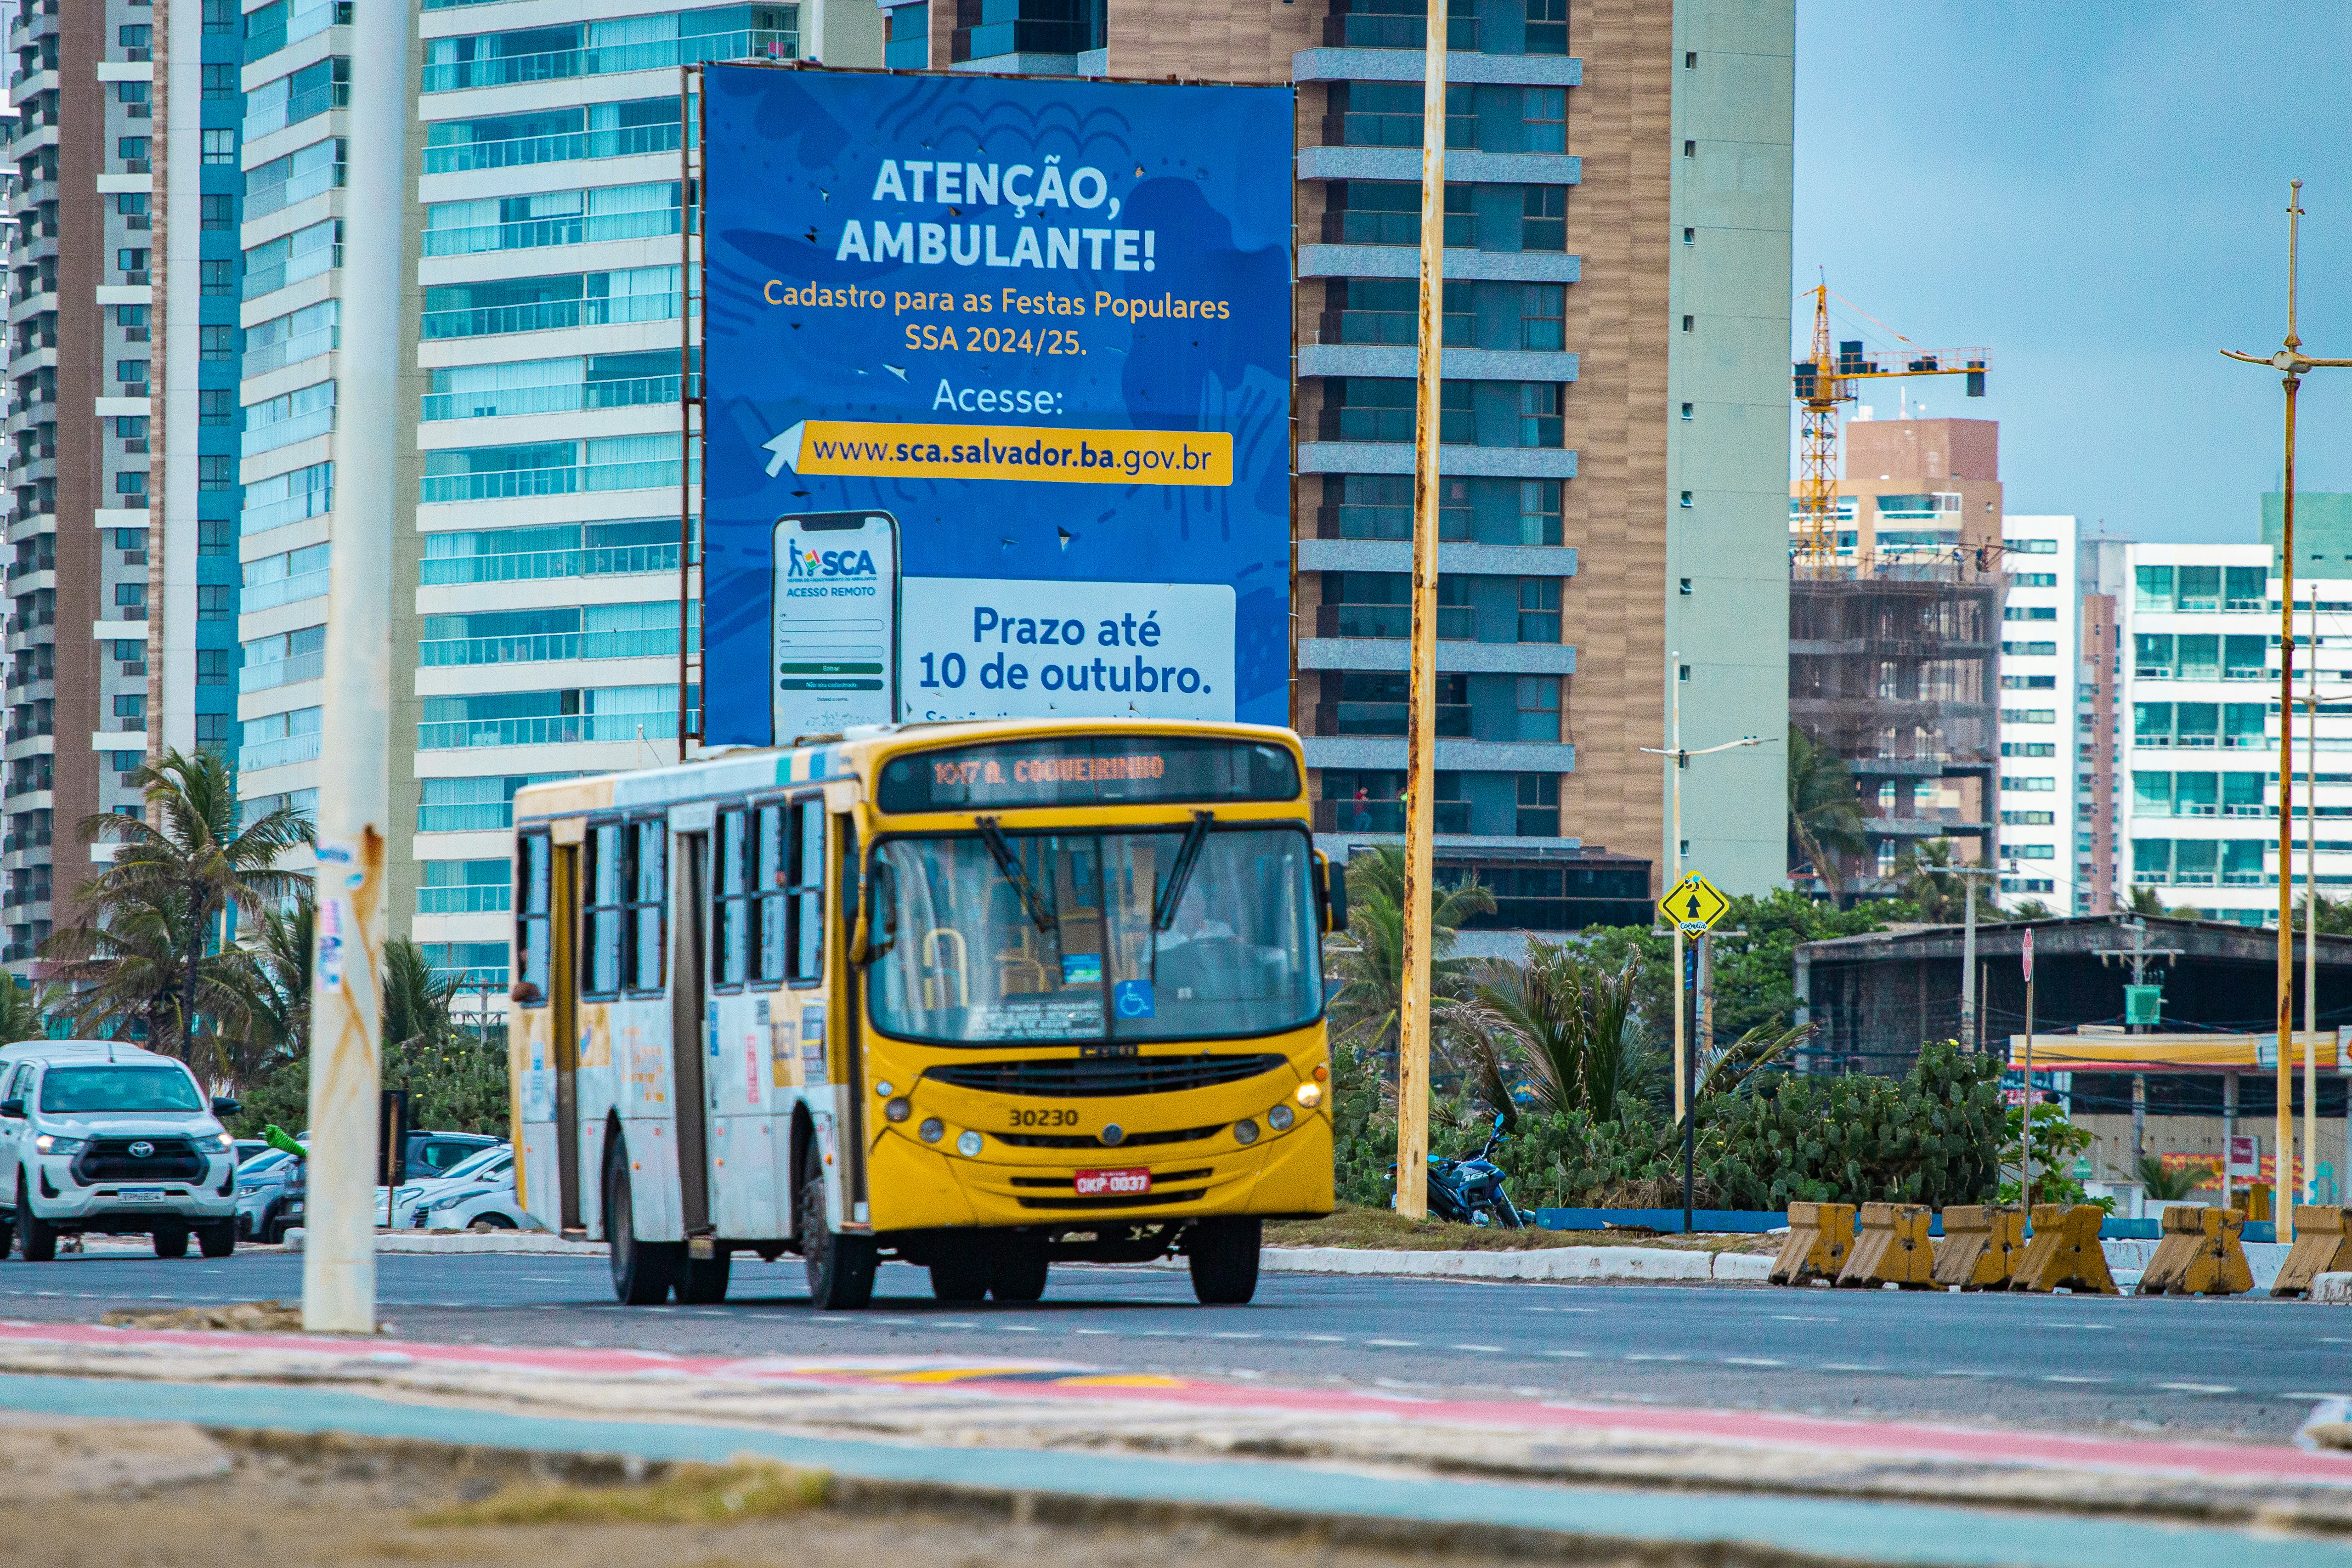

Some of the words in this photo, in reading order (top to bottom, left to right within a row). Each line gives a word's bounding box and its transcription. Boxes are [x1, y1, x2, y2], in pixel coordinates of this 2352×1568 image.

[872, 155, 1120, 220] ATENÇÃO,
[837, 220, 1155, 272] AMBULANTE!
[763, 279, 886, 309] Cadastro
[895, 291, 954, 316] para
[963, 294, 993, 313] as
[1002, 288, 1086, 316] Festas
[1095, 291, 1230, 324] Populares
[905, 324, 959, 351] SSA
[967, 327, 1087, 356] 2024/25.
[933, 379, 1063, 414] Acesse:
[813, 437, 1212, 475] www.sca.salvador.ba.gov.br
[821, 549, 876, 576] SCA
[786, 587, 828, 597] ACESSO
[831, 586, 876, 597] REMOTO
[974, 606, 1086, 646] Prazo
[1097, 610, 1161, 647] até
[920, 652, 967, 689] 10
[980, 652, 1029, 691] de
[1040, 655, 1211, 694] outubro.
[1009, 1109, 1078, 1126] 30230
[1077, 1177, 1107, 1193] OKP
[1110, 1175, 1147, 1191] 0037
